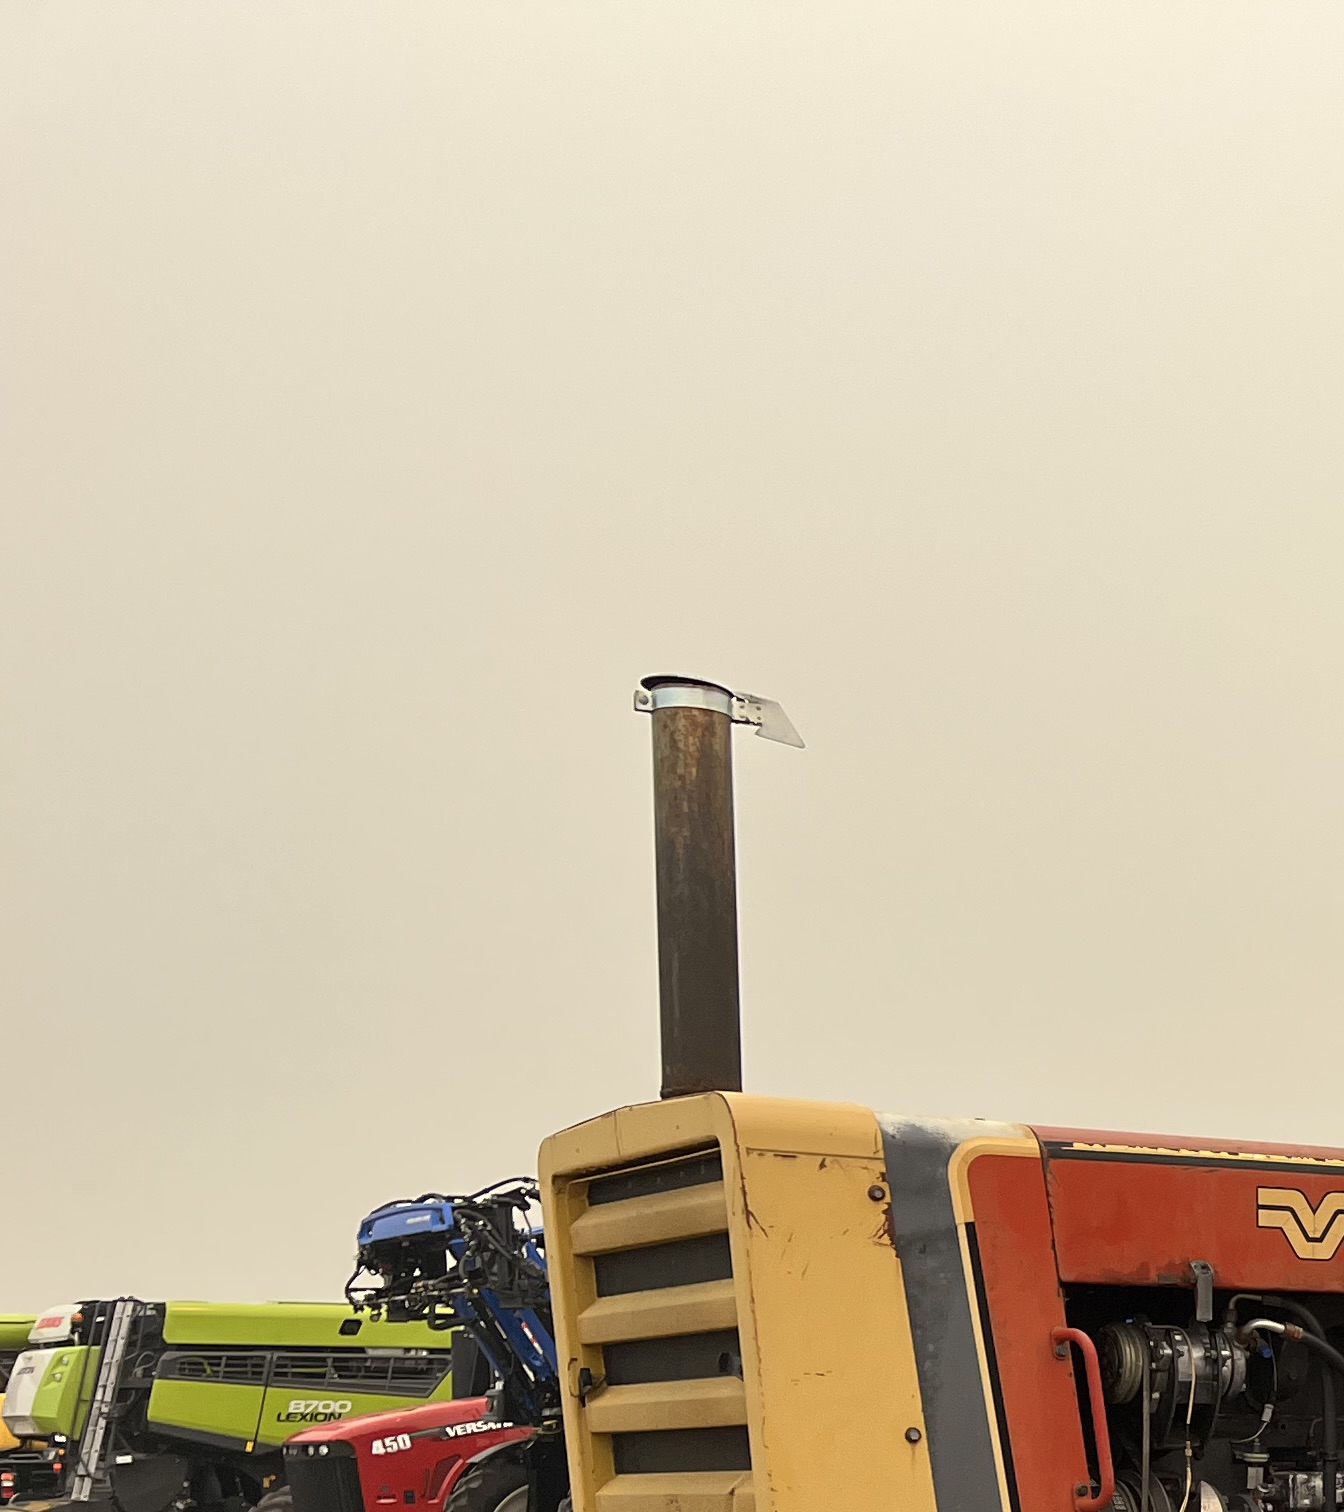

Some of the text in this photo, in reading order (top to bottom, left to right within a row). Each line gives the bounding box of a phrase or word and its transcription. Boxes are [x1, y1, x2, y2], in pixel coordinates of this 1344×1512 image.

[288, 1399, 352, 1413] 8700
[276, 1412, 342, 1423] LEXION
[371, 1433, 412, 1456] 450
